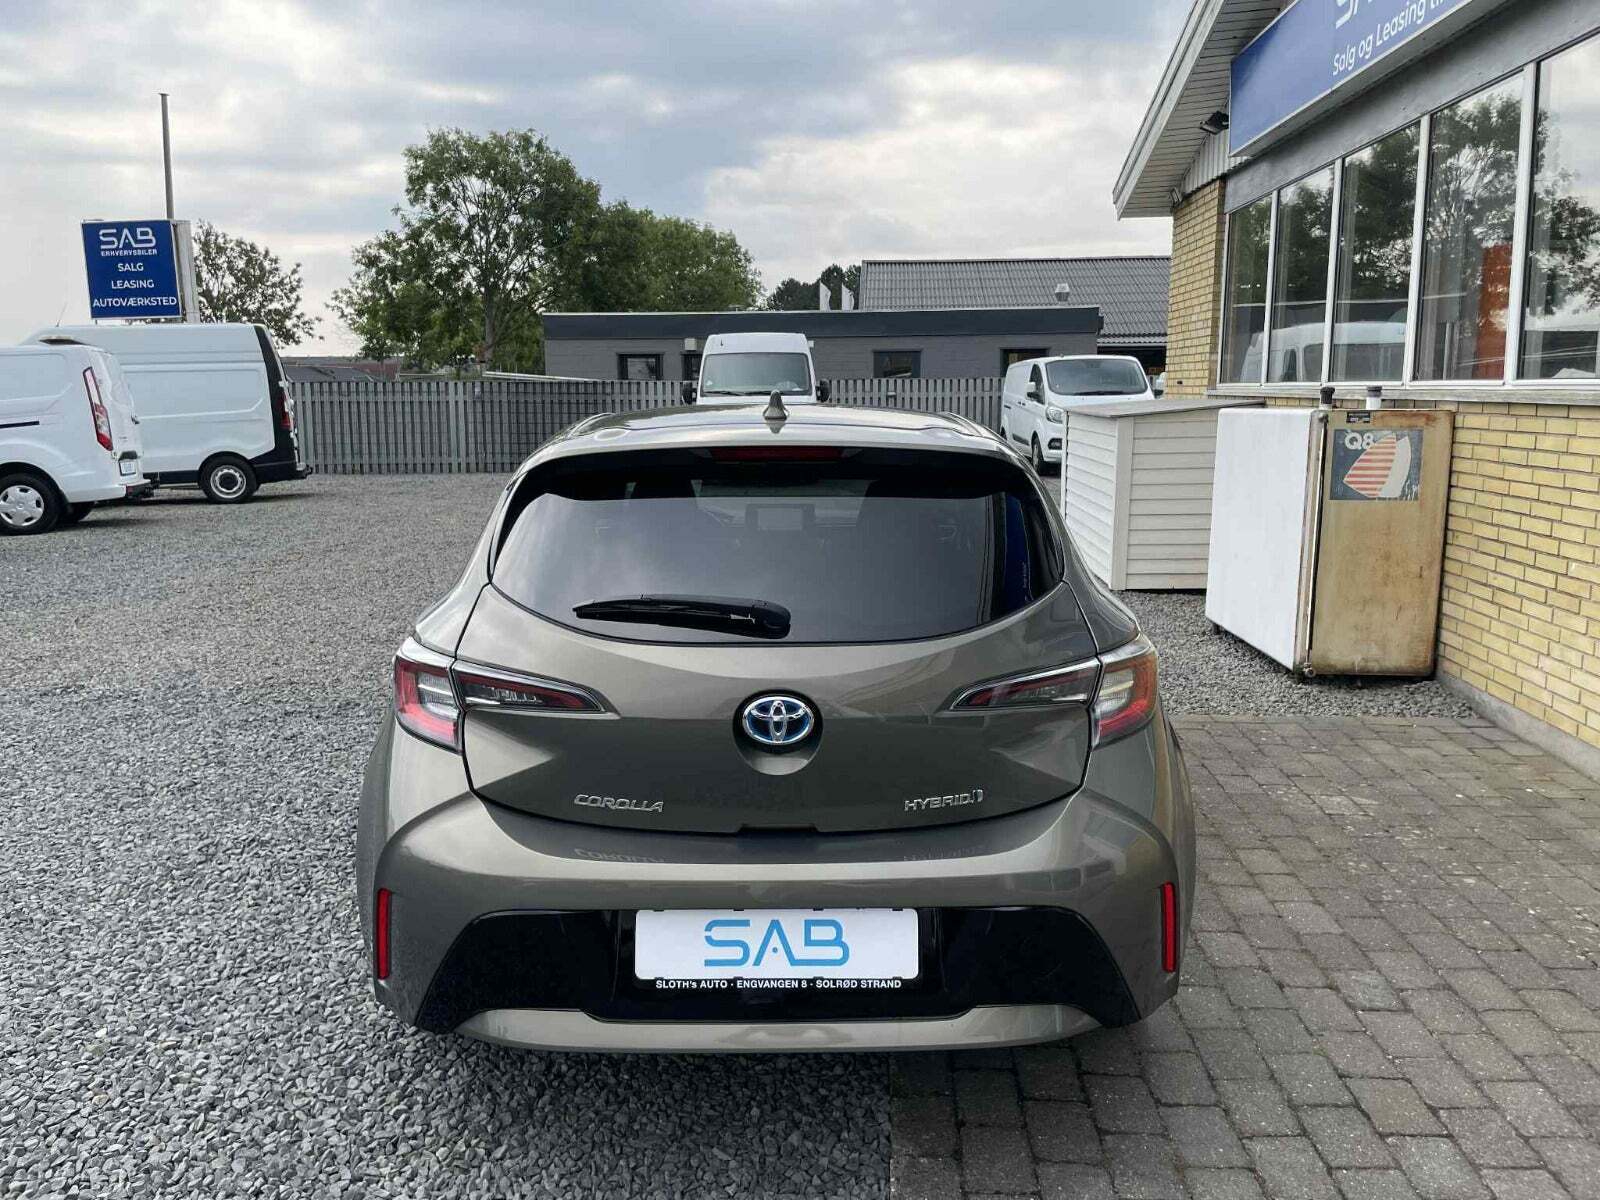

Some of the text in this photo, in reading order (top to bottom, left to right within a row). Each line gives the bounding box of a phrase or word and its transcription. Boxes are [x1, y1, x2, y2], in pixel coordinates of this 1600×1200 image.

[1332, 43, 1356, 76] Salg
[1358, 33, 1373, 59] og
[1376, 0, 1425, 47] Leasing
[99, 227, 156, 249] SAB
[118, 263, 144, 271] SALG
[111, 279, 155, 289] LEASING
[93, 296, 177, 307] AUTOVÆRKSTED
[1344, 431, 1374, 450] Q8
[574, 794, 664, 812] COROLLA
[704, 919, 850, 966] SAB
[655, 979, 902, 989] SLOTH's AUTO ENGVANGEN 8 SOLRØD STRAND
